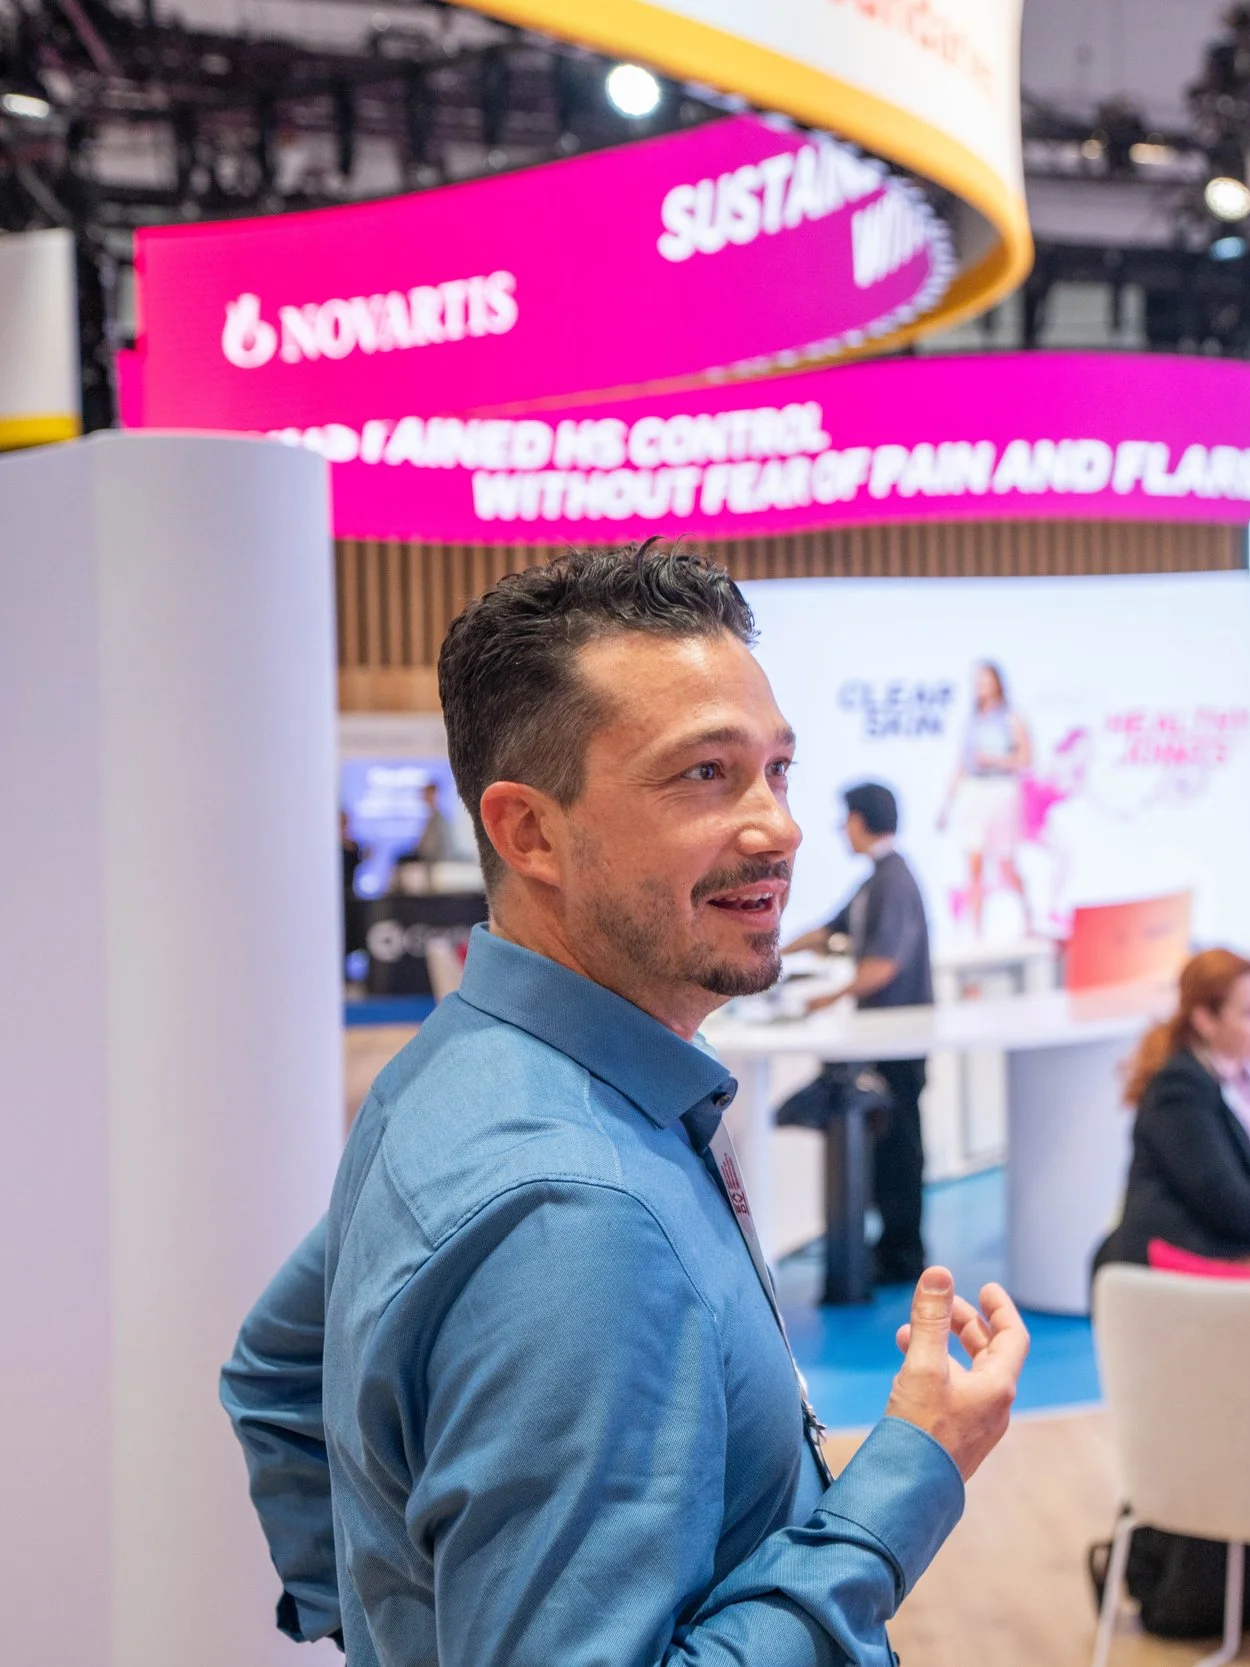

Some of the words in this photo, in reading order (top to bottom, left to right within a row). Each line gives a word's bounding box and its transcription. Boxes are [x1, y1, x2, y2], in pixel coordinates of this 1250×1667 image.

[278, 270, 518, 363] NOVARTIS
[627, 400, 832, 469] CONTROL
[471, 465, 701, 522] WITHOUT
[700, 455, 814, 516] FEAR
[810, 446, 872, 505] OF
[867, 440, 996, 500] PAIN
[993, 438, 1113, 495] AND
